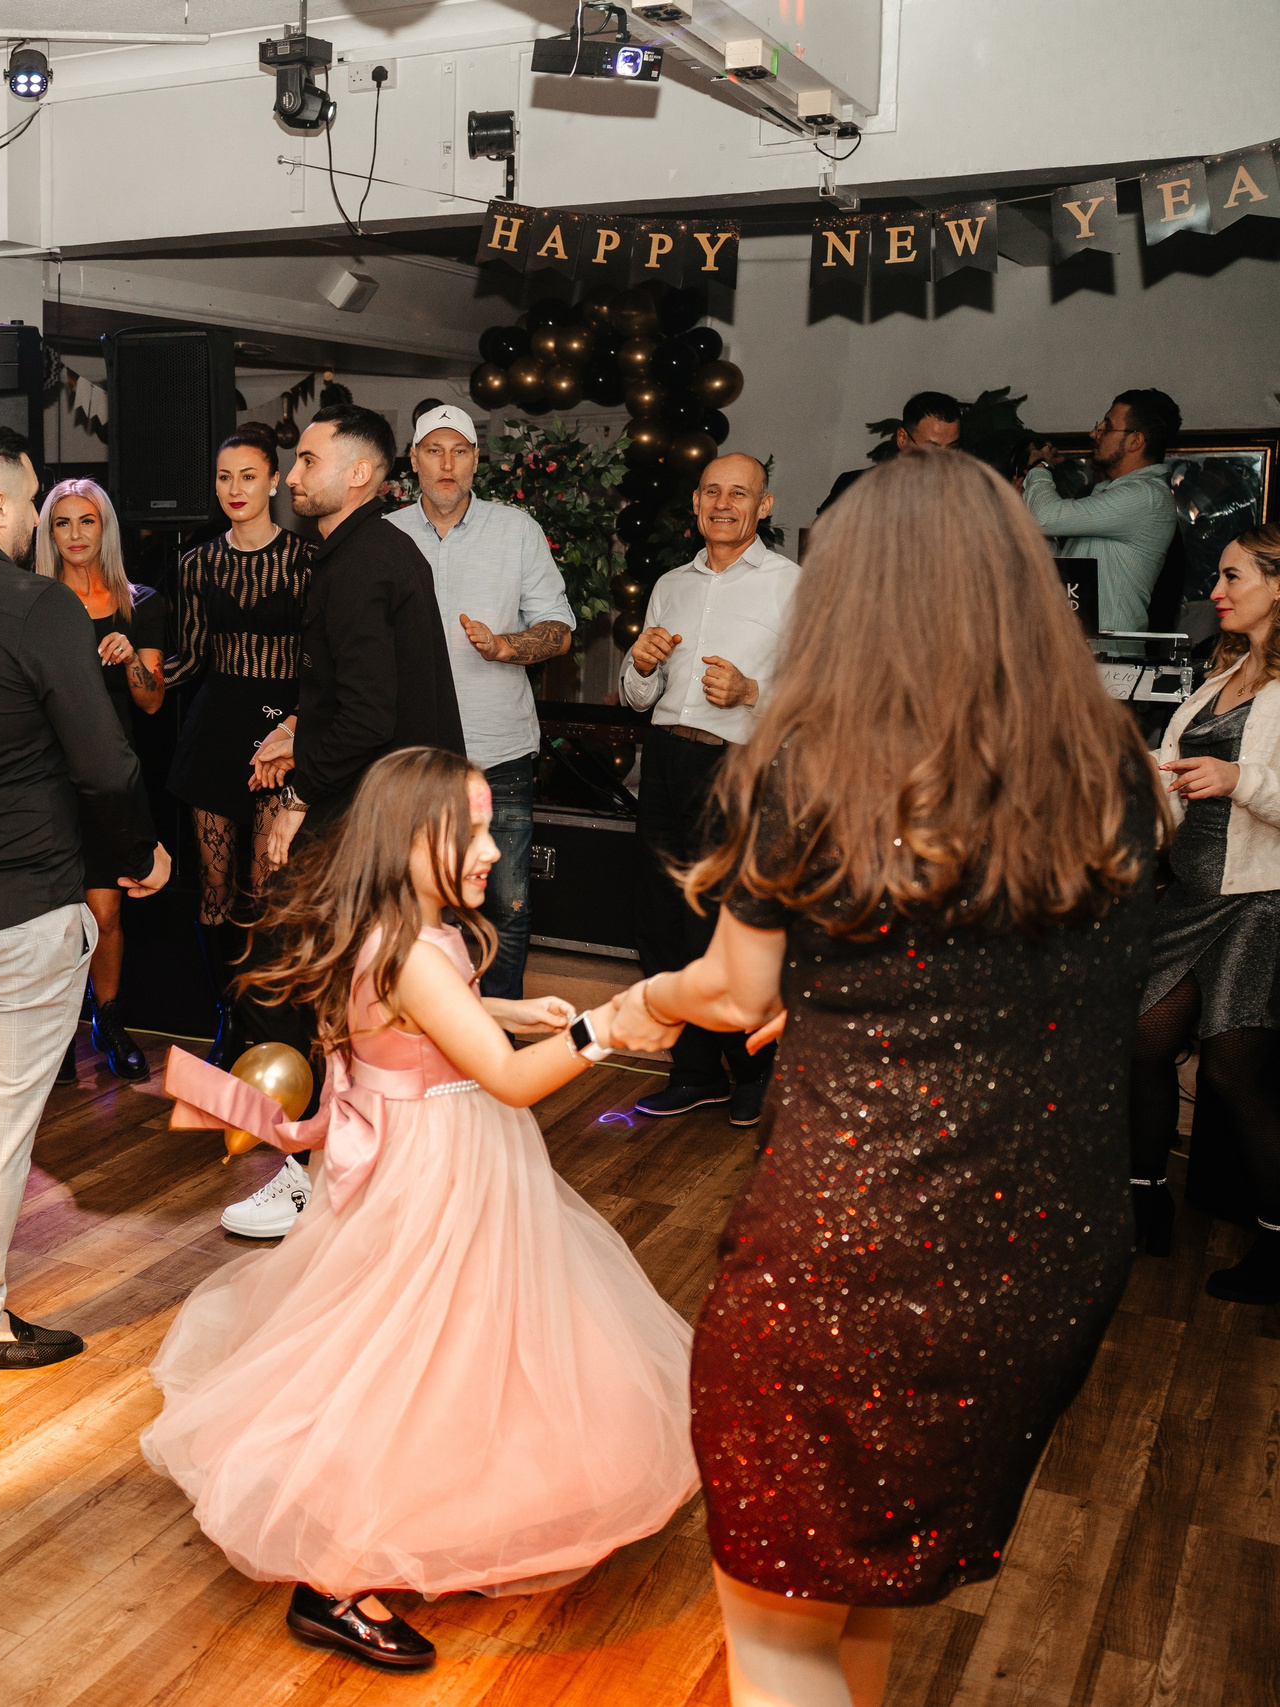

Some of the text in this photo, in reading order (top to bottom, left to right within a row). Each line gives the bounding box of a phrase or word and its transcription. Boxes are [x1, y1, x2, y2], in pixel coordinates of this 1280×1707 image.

[487, 213, 732, 271] HAPPY
[821, 216, 988, 266] NEW
[1067, 583, 1079, 599] K
